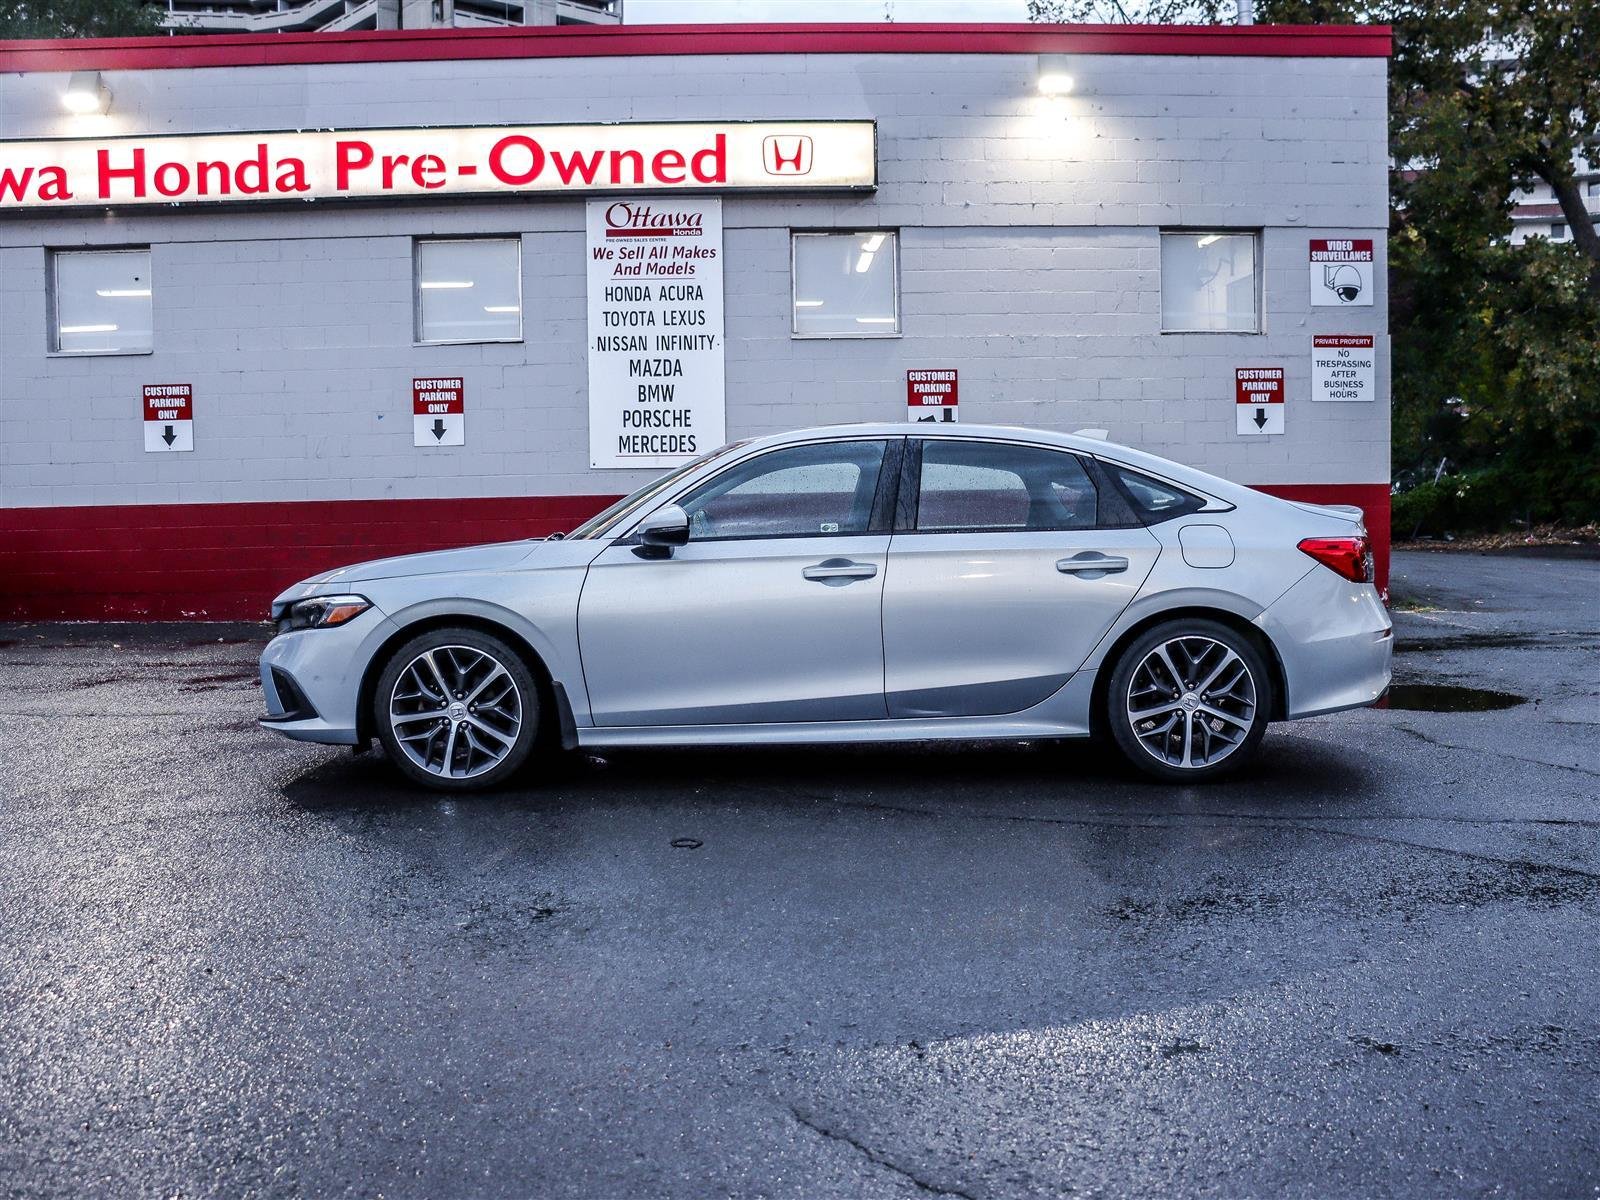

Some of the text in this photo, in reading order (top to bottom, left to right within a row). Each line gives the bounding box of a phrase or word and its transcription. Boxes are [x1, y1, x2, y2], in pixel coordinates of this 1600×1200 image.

[97, 143, 311, 199] Honda
[336, 134, 726, 191] Pre-Owned
[605, 202, 702, 228] Ottawa
[1327, 240, 1353, 250] VIDEO
[593, 245, 716, 260] We Sell All Makes
[1311, 251, 1372, 261] SURVEILLANCE
[613, 262, 695, 275] And Models
[605, 285, 704, 302] HONDA ACURA
[603, 310, 706, 327] TOYOTA LEXUS
[597, 335, 715, 351] NISSAN INFINITY
[629, 359, 683, 377] MAZDA
[1316, 360, 1371, 368] TRESPASSING
[909, 371, 956, 381] CUSTOMER
[1237, 370, 1282, 379] CUSTOMER
[1331, 370, 1356, 378] AFTER
[415, 380, 461, 389] CUSTOMER
[914, 384, 951, 393] PARKING
[1242, 381, 1278, 391] PARKING
[1324, 380, 1364, 388] BUSINESS
[145, 386, 190, 396] CUSTOMER
[638, 385, 675, 402] BMW
[420, 392, 457, 401] PARKING
[922, 395, 943, 405] ONLY
[1250, 393, 1270, 402] ONLY
[150, 398, 186, 408] PARKING
[428, 404, 449, 413] ONLY
[158, 410, 178, 419] ONLY
[623, 410, 692, 428] PORSCHE
[618, 435, 697, 453] MERCEDES
